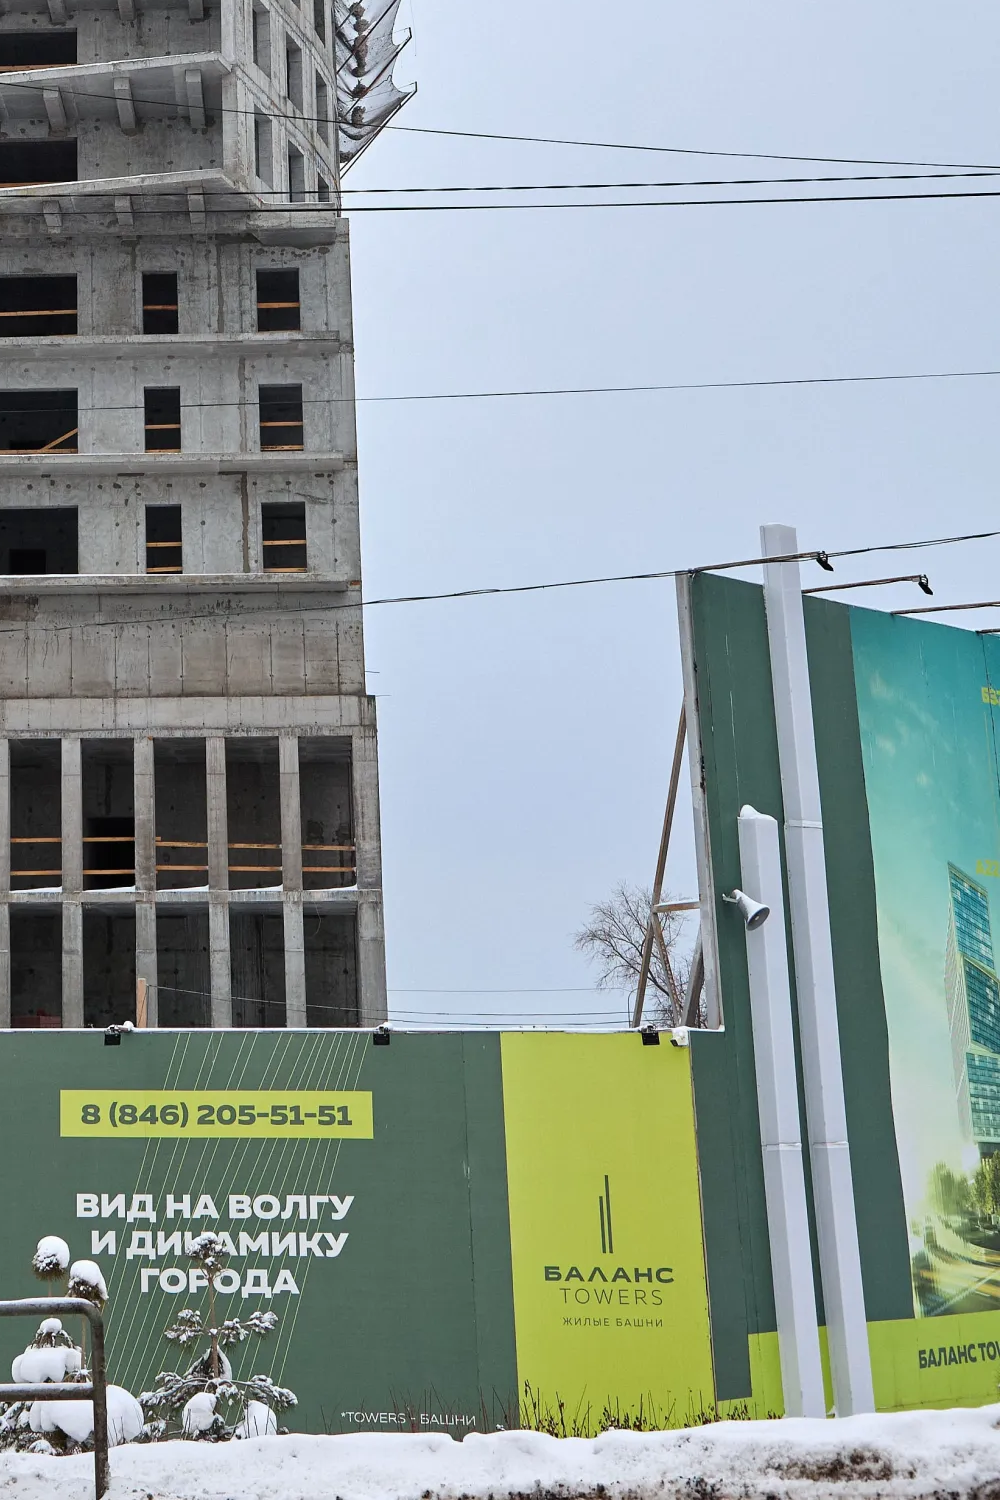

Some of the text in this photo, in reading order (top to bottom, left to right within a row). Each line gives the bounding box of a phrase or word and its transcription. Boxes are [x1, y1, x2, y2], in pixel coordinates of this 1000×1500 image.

[81, 1102, 353, 1127] 8 (846) 205-51-51
[76, 1193, 355, 1223] ВИД НА ВОЛГУ
[91, 1230, 117, 1255] И
[140, 1268, 300, 1299] ГОРОДА
[544, 1266, 675, 1284] БАЛАНС
[559, 1288, 664, 1306] TOWERS
[562, 1317, 664, 1328] ЖИЛЫЕ БАШНИ
[918, 1343, 978, 1369] БАЛАНС
[420, 1413, 476, 1426] БАШНИ
